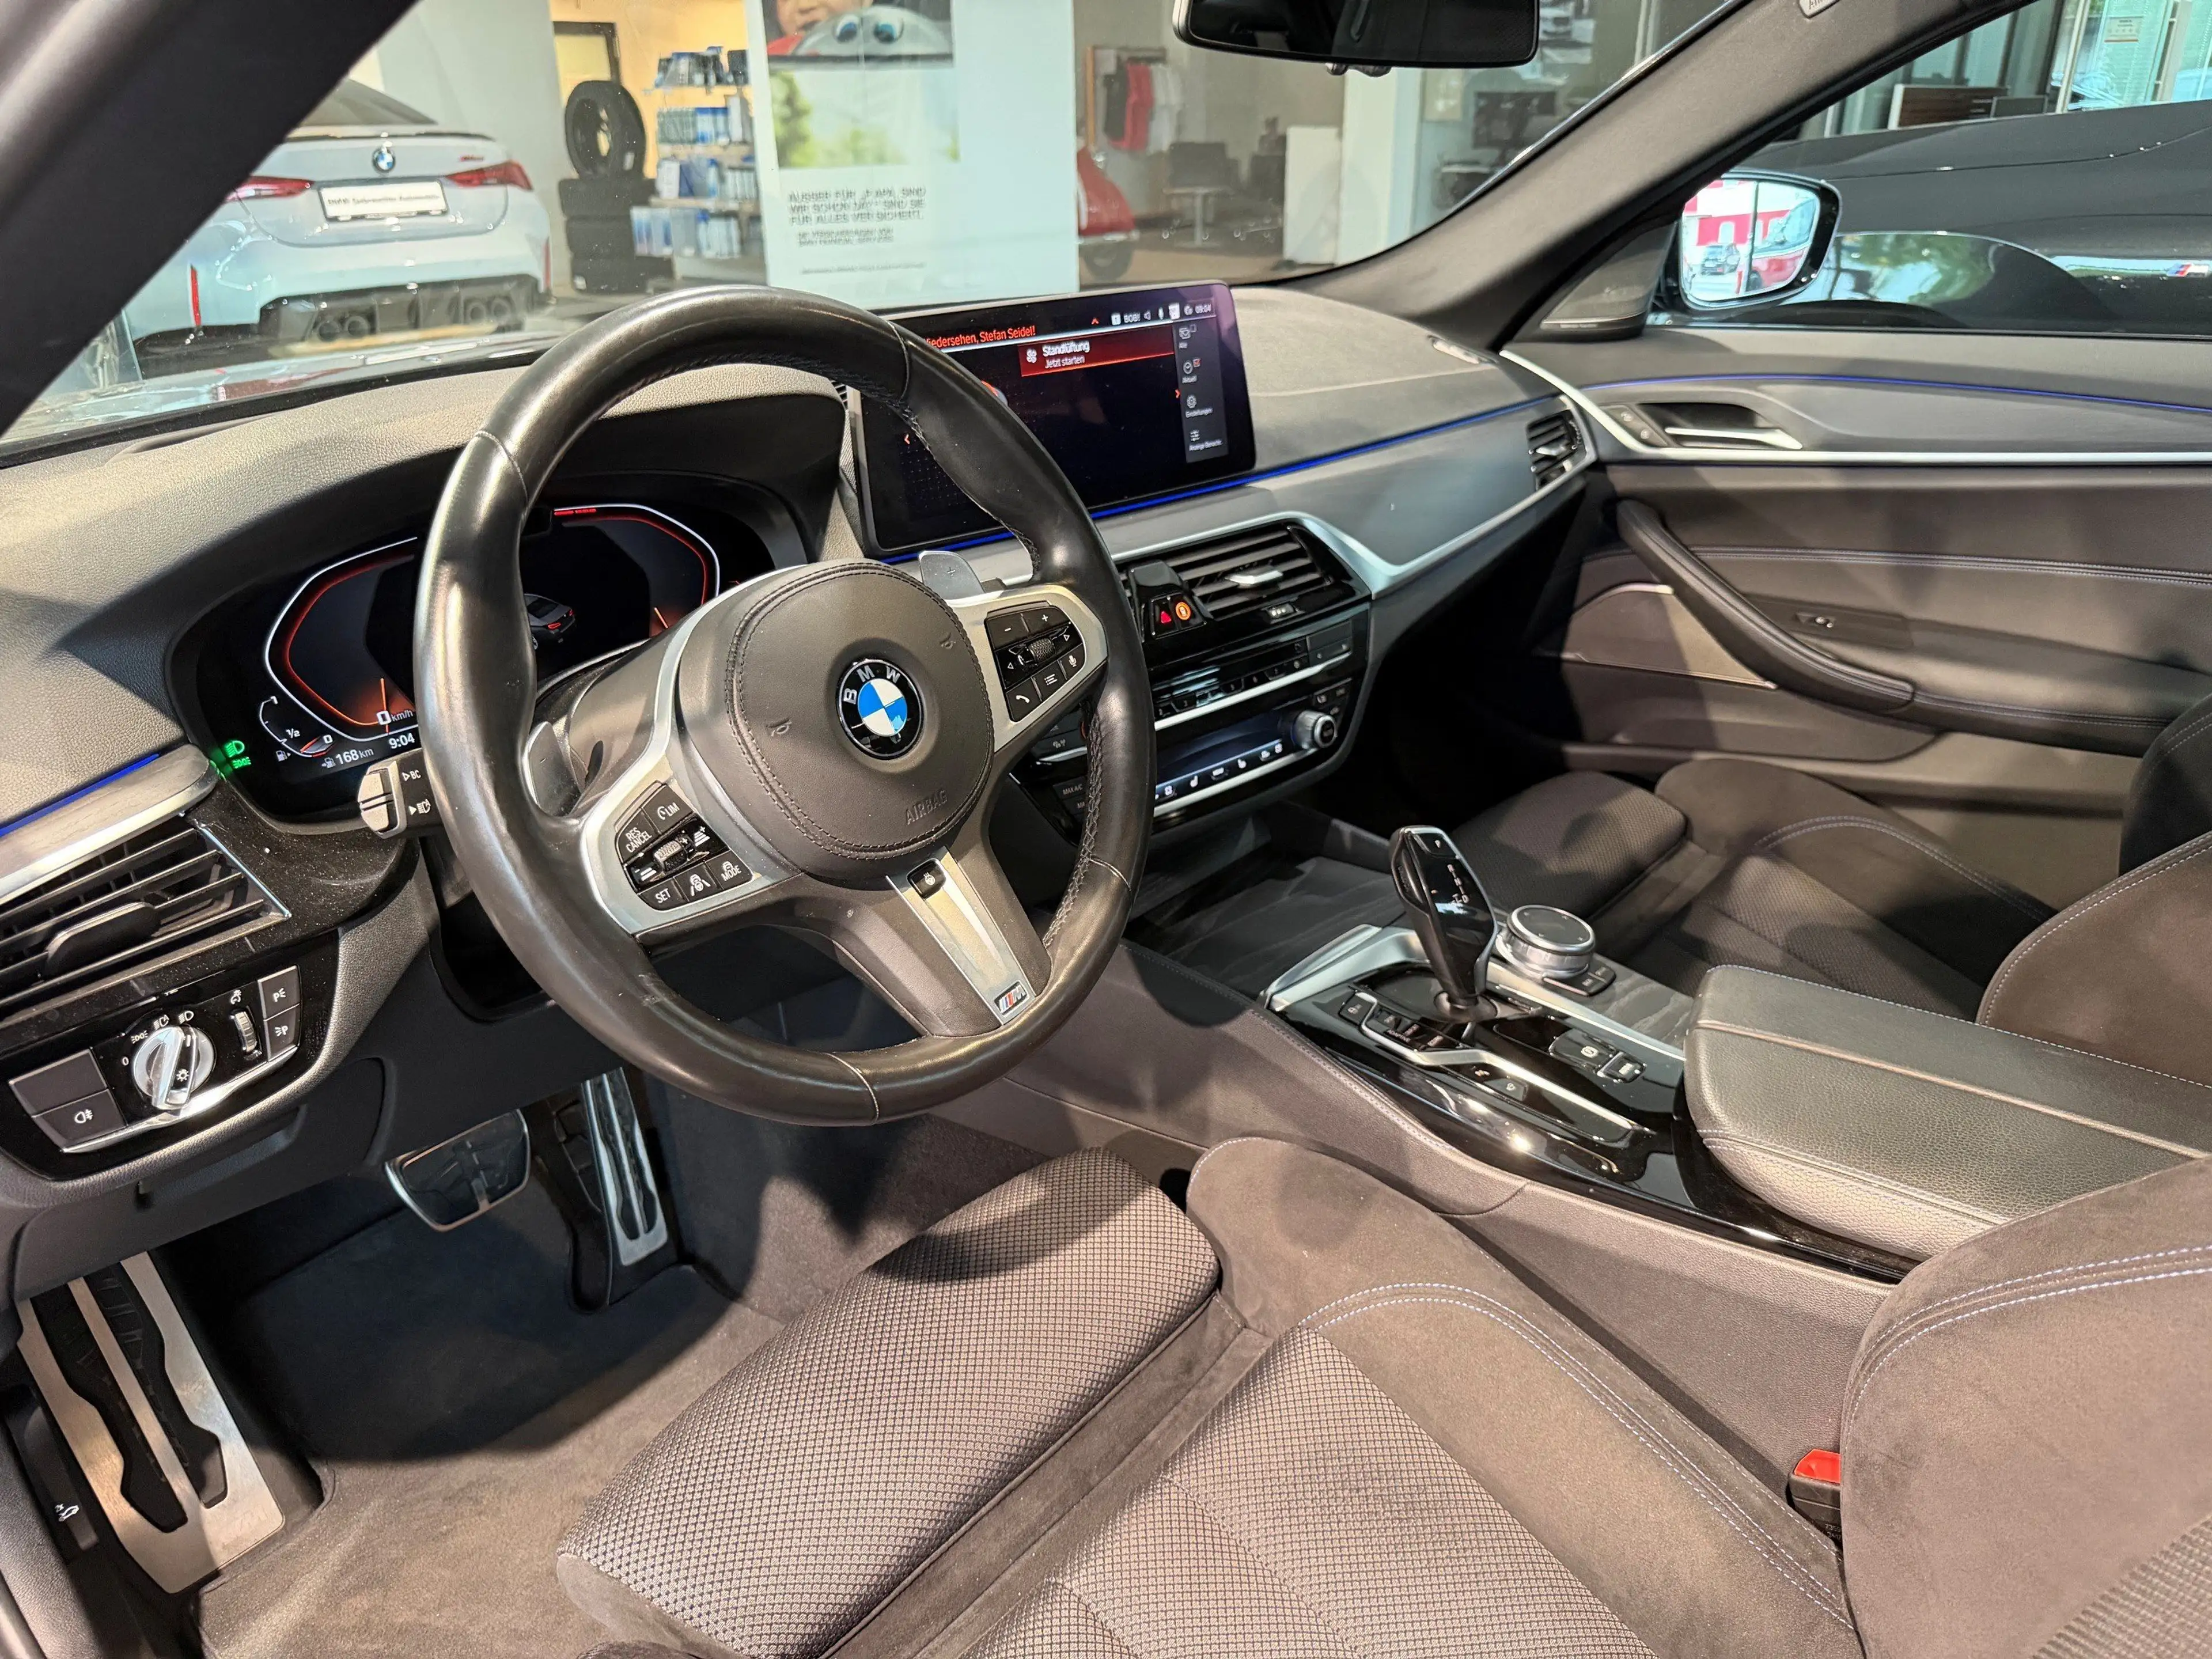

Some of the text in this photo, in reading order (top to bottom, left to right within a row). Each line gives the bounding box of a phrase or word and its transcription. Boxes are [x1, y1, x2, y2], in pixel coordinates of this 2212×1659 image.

[926, 325, 1036, 348] iedersehen, Stefan Seidel!
[1043, 340, 1090, 358] Standlüftung
[1044, 355, 1085, 369] Jetzt starten
[843, 665, 901, 704] BMW
[391, 709, 414, 722] km/h
[389, 732, 415, 749] 9:04
[335, 748, 374, 764] 168 km
[411, 770, 421, 779] BC
[668, 802, 680, 817] LIM
[626, 827, 641, 841] RES
[626, 831, 652, 853] CANCEL
[721, 865, 742, 881] MODE
[656, 888, 671, 903] SET
